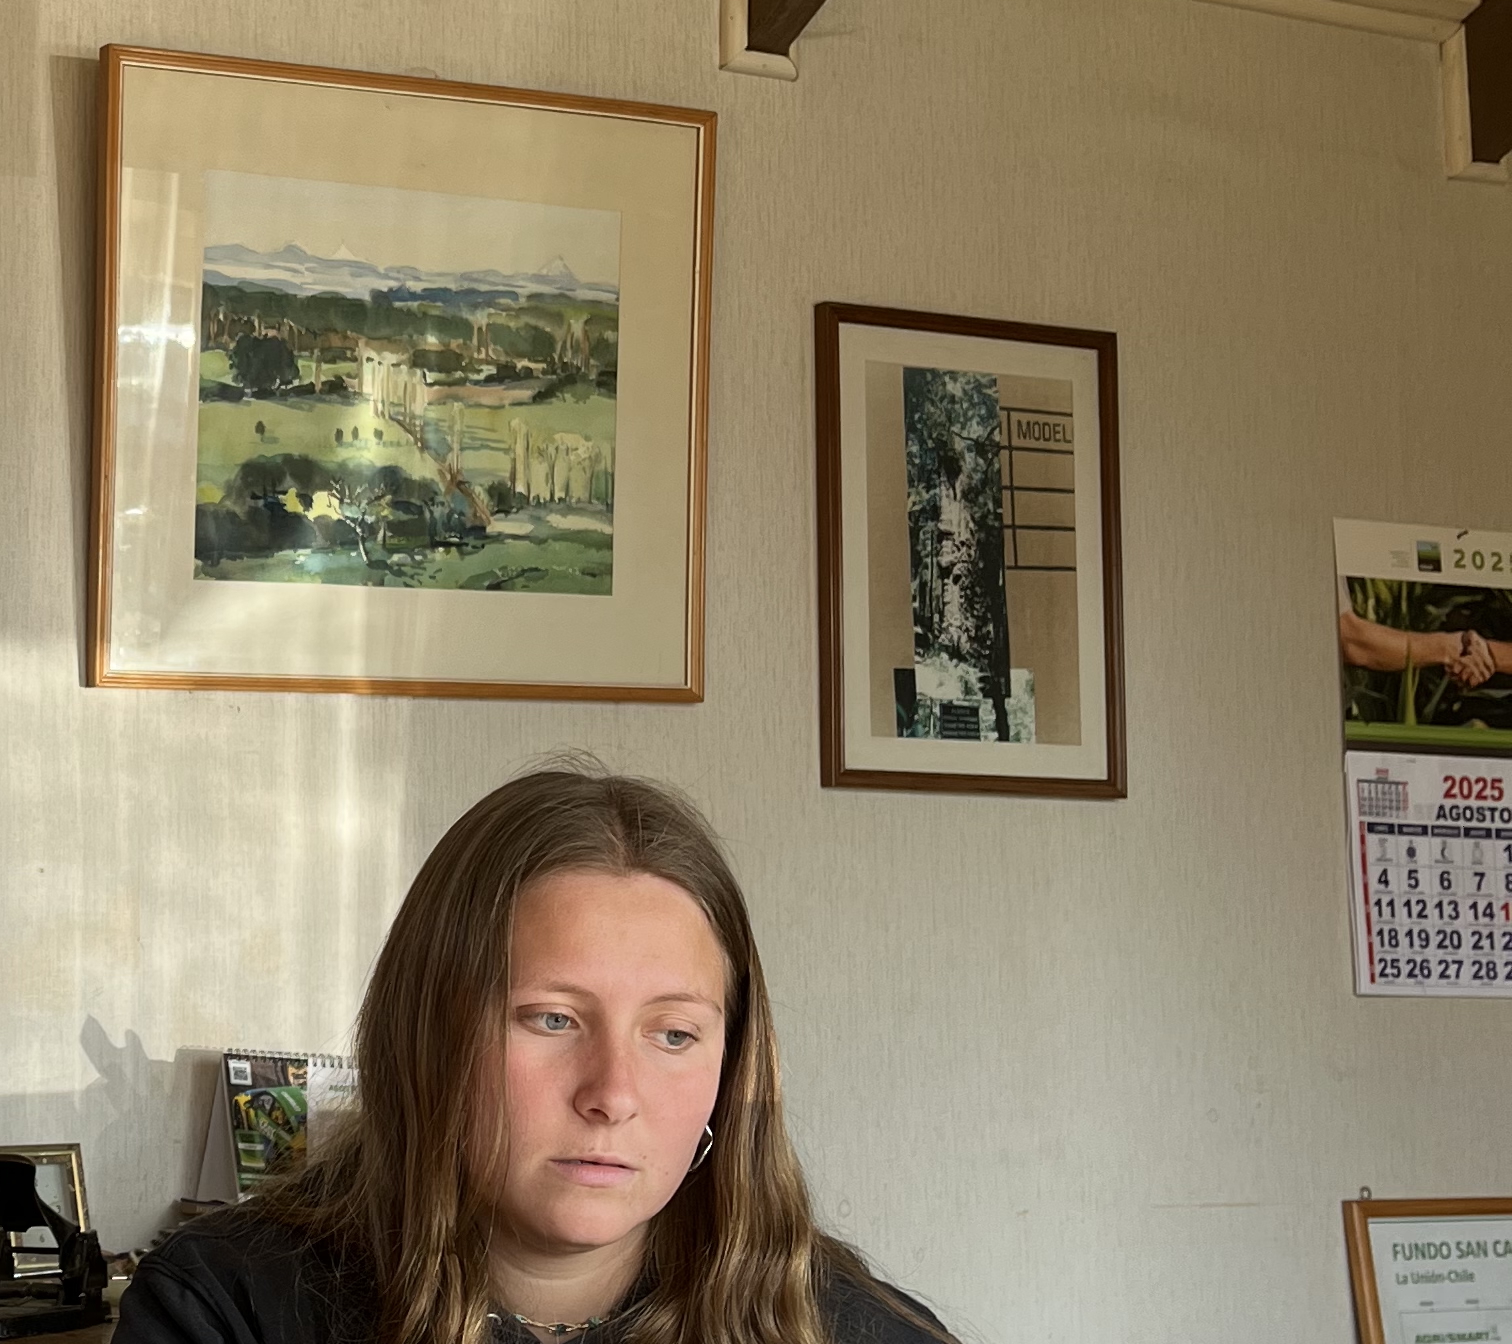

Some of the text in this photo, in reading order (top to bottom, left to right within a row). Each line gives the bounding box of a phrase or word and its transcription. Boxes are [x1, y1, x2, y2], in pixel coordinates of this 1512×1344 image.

[1016, 419, 1073, 445] MODEL
[1453, 548, 1512, 573] 202
[1442, 775, 1505, 802] 2025
[1436, 804, 1512, 824] AGOSTO
[1377, 867, 1389, 889] 4
[1407, 869, 1419, 889] 5
[1439, 870, 1452, 891] 6
[1472, 872, 1486, 892] 7
[1374, 898, 1495, 922] 11 12 13 14
[1376, 927, 1495, 951] 18 19 20 21
[1378, 957, 1498, 982] 25 26 27 28
[1392, 1240, 1452, 1262] FUNDO
[1455, 1239, 1488, 1260] SAN
[1395, 1272, 1408, 1285] La
